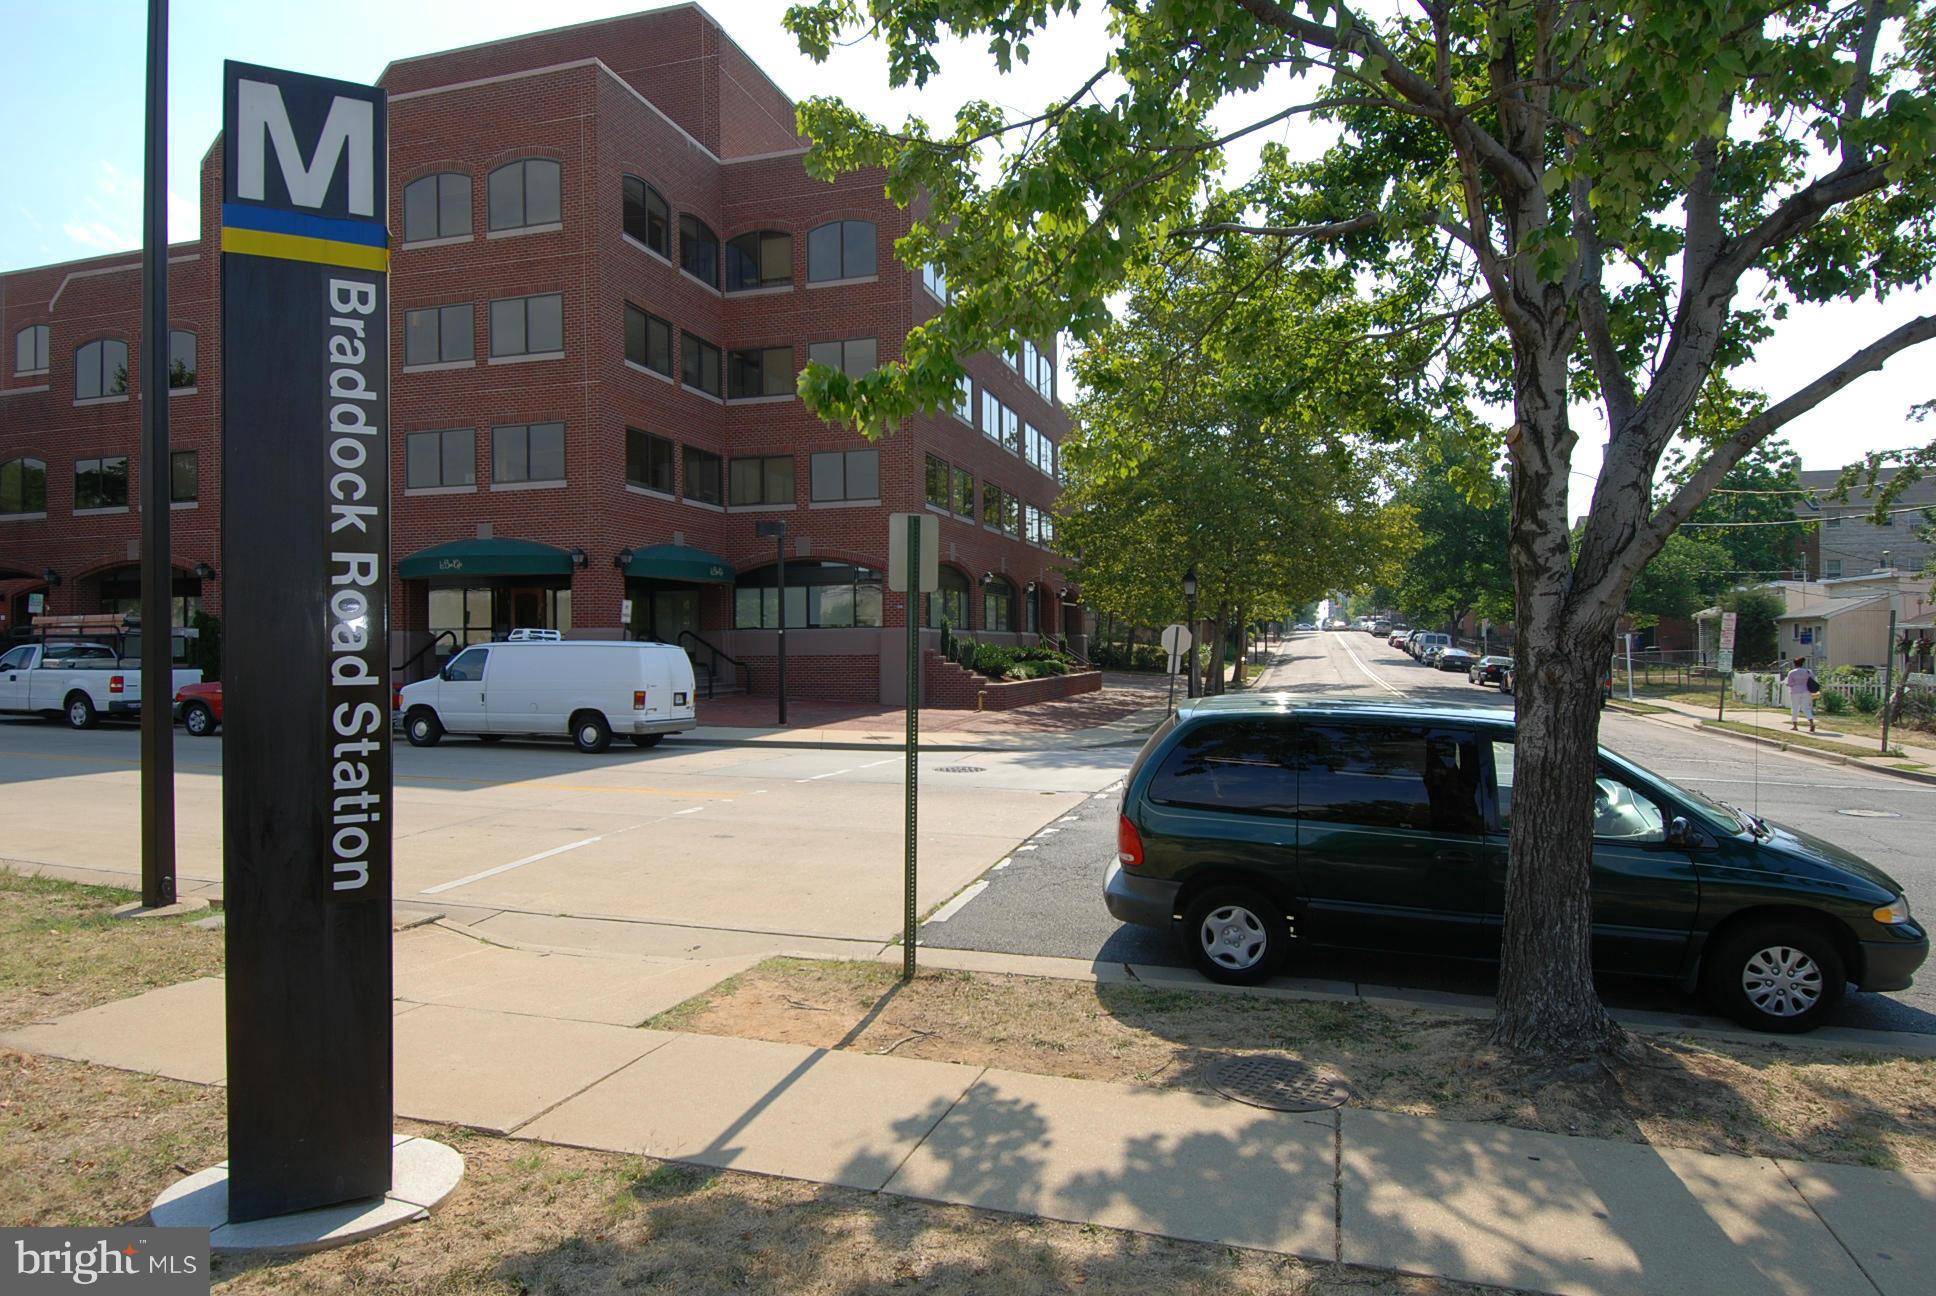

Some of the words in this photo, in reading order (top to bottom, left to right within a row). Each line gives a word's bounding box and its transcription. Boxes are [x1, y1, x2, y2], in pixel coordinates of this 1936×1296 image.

[237, 78, 374, 218] M
[328, 277, 378, 534] Braddock
[331, 552, 380, 687] Road
[332, 702, 381, 891] Station
